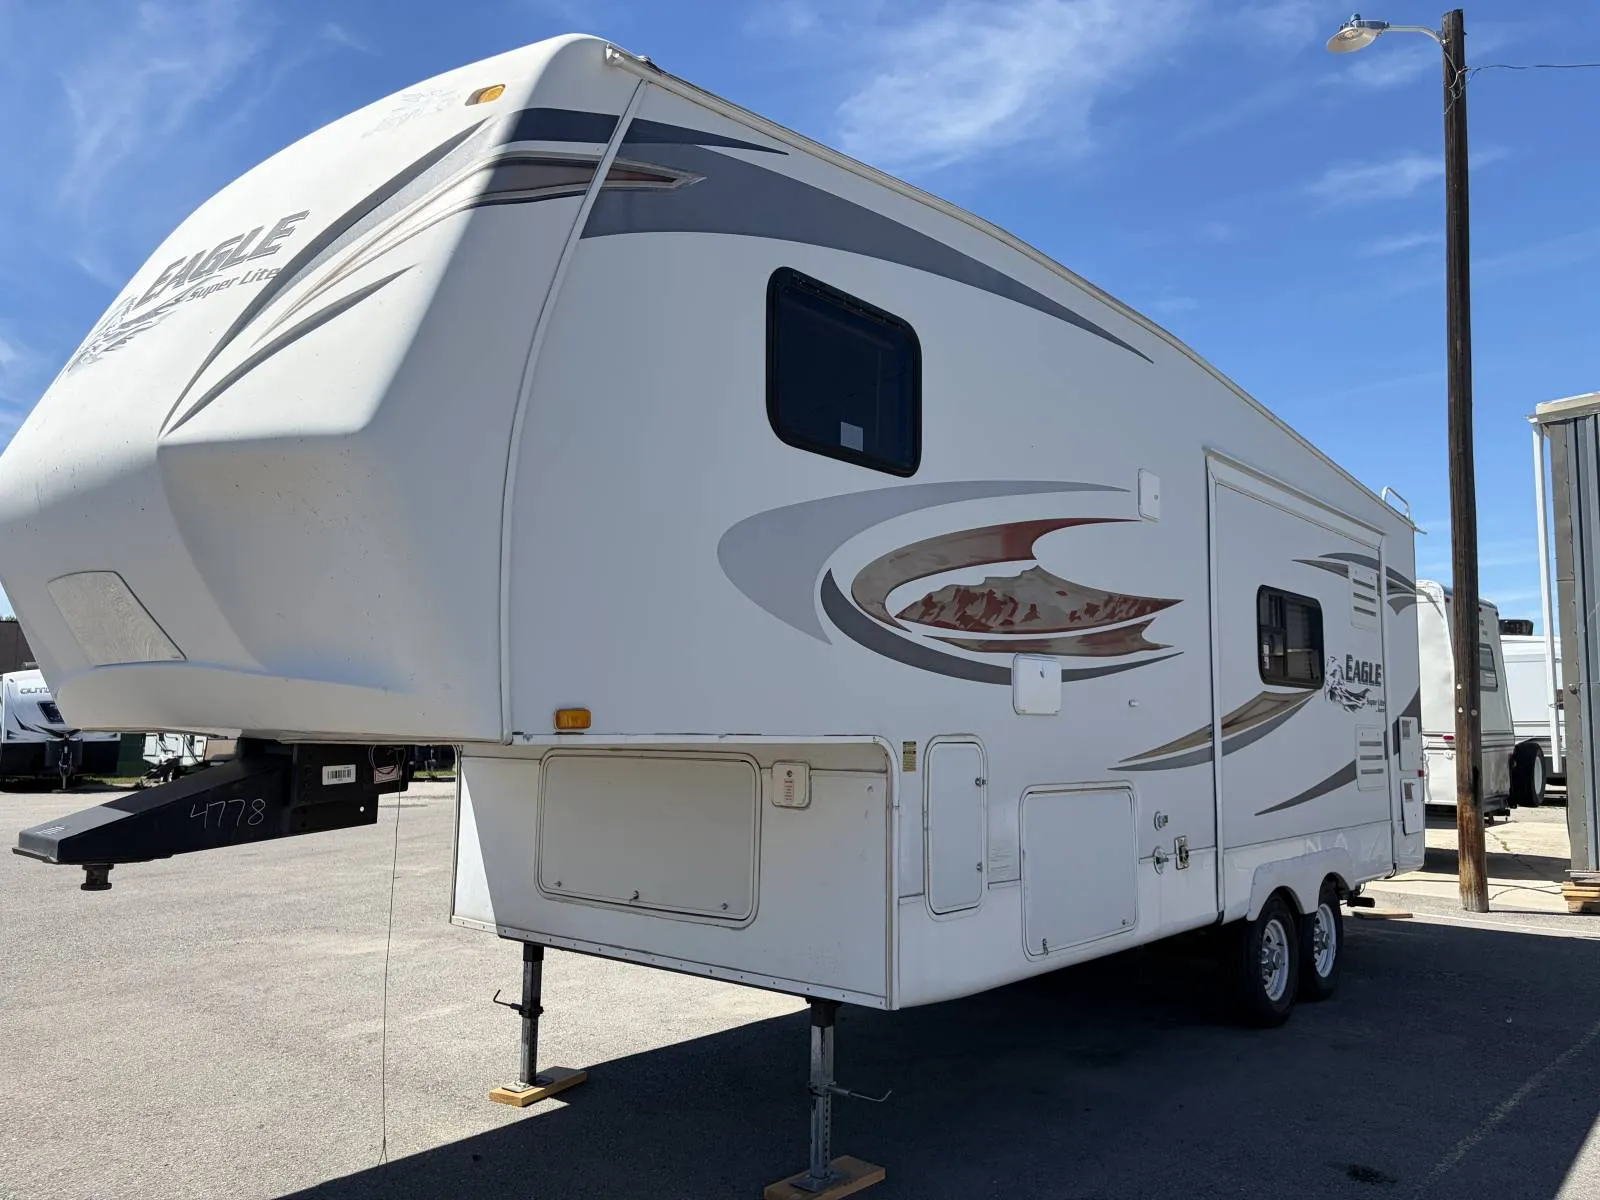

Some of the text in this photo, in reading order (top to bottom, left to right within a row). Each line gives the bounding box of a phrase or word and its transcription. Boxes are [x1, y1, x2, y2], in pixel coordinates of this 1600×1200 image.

[239, 267, 281, 285] Lite
[1346, 654, 1382, 687] EAGLE
[189, 798, 266, 829] 4778
